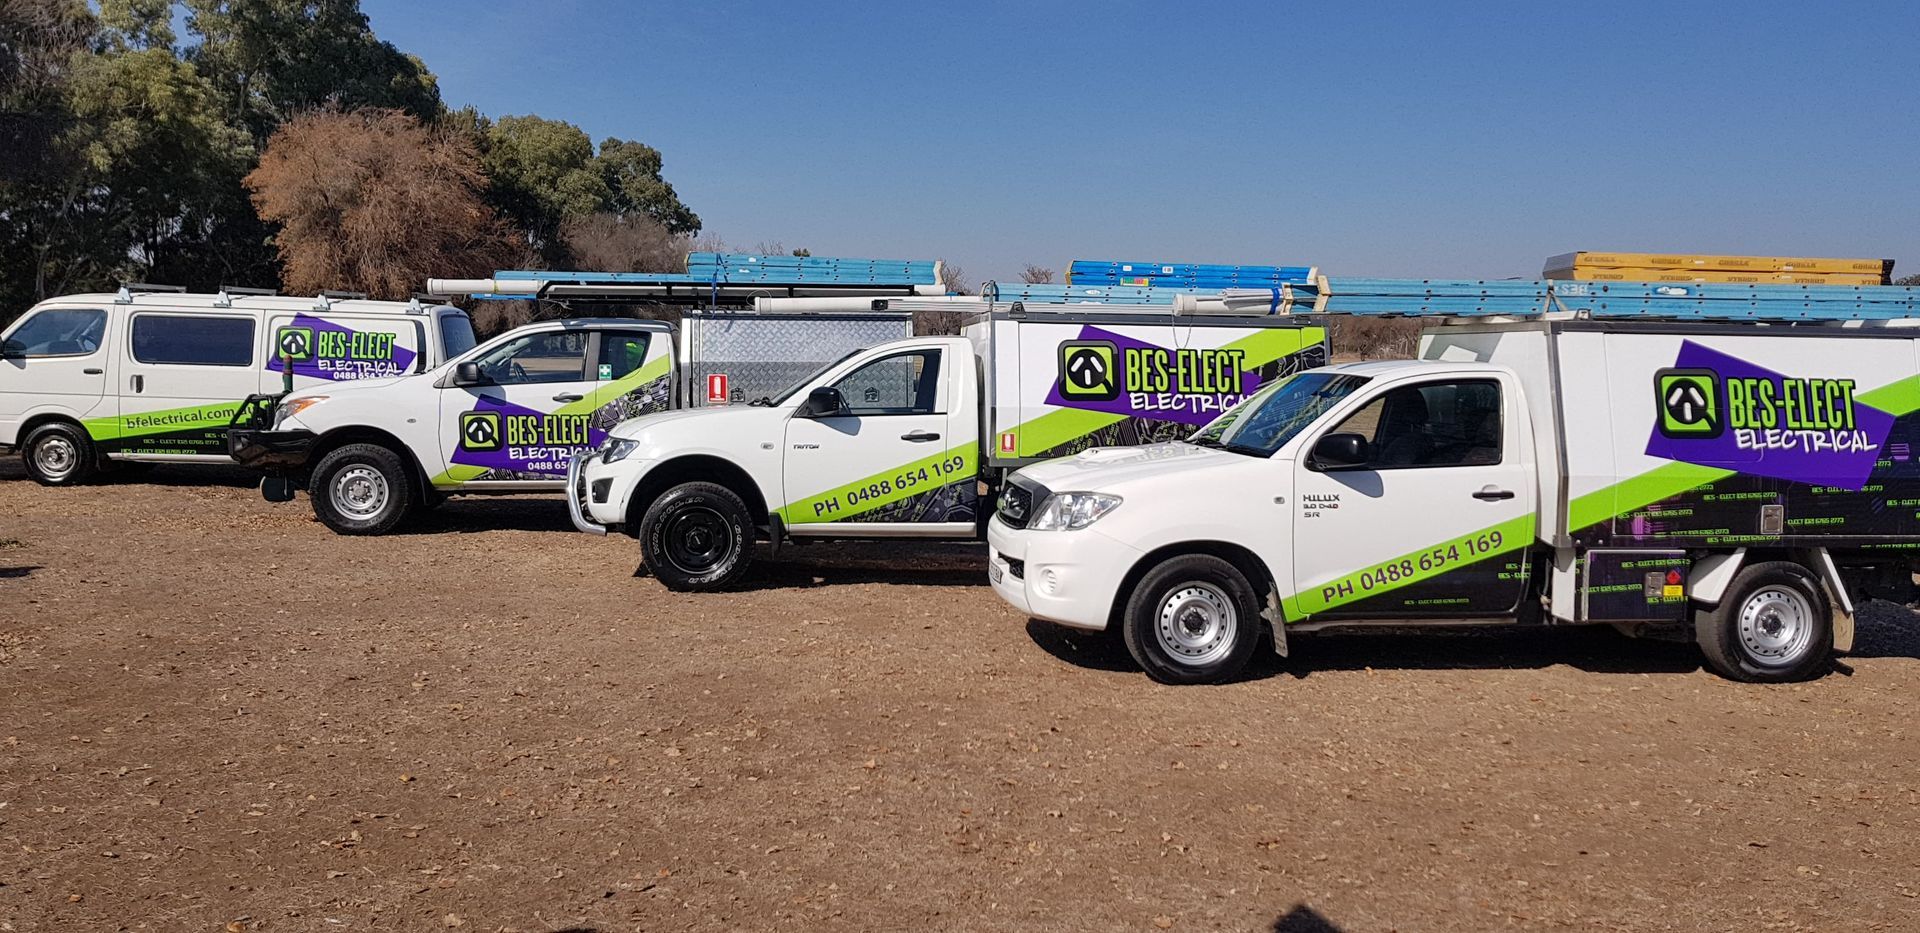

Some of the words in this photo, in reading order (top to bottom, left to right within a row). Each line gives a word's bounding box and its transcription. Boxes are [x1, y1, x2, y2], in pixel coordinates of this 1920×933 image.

[318, 331, 396, 360] BES-ELECT
[318, 360, 403, 375] ELECTRICAL
[333, 372, 357, 380] 0488
[1125, 348, 1245, 393] BES-ELECT
[1727, 378, 1856, 430] BES-ELECT
[506, 414, 591, 445] BES-ELECT
[1734, 428, 1878, 454] ELECTRICAL
[528, 462, 552, 470] 0488
[554, 461, 569, 470] 65
[813, 496, 841, 517] PH
[847, 480, 892, 506] 0488
[895, 467, 929, 490] 654
[931, 455, 965, 477] 169
[1303, 494, 1340, 502] HILUX
[1322, 580, 1354, 603] PH
[1360, 559, 1415, 591] 0488
[1419, 544, 1460, 572] 654
[1464, 530, 1504, 556] 169
